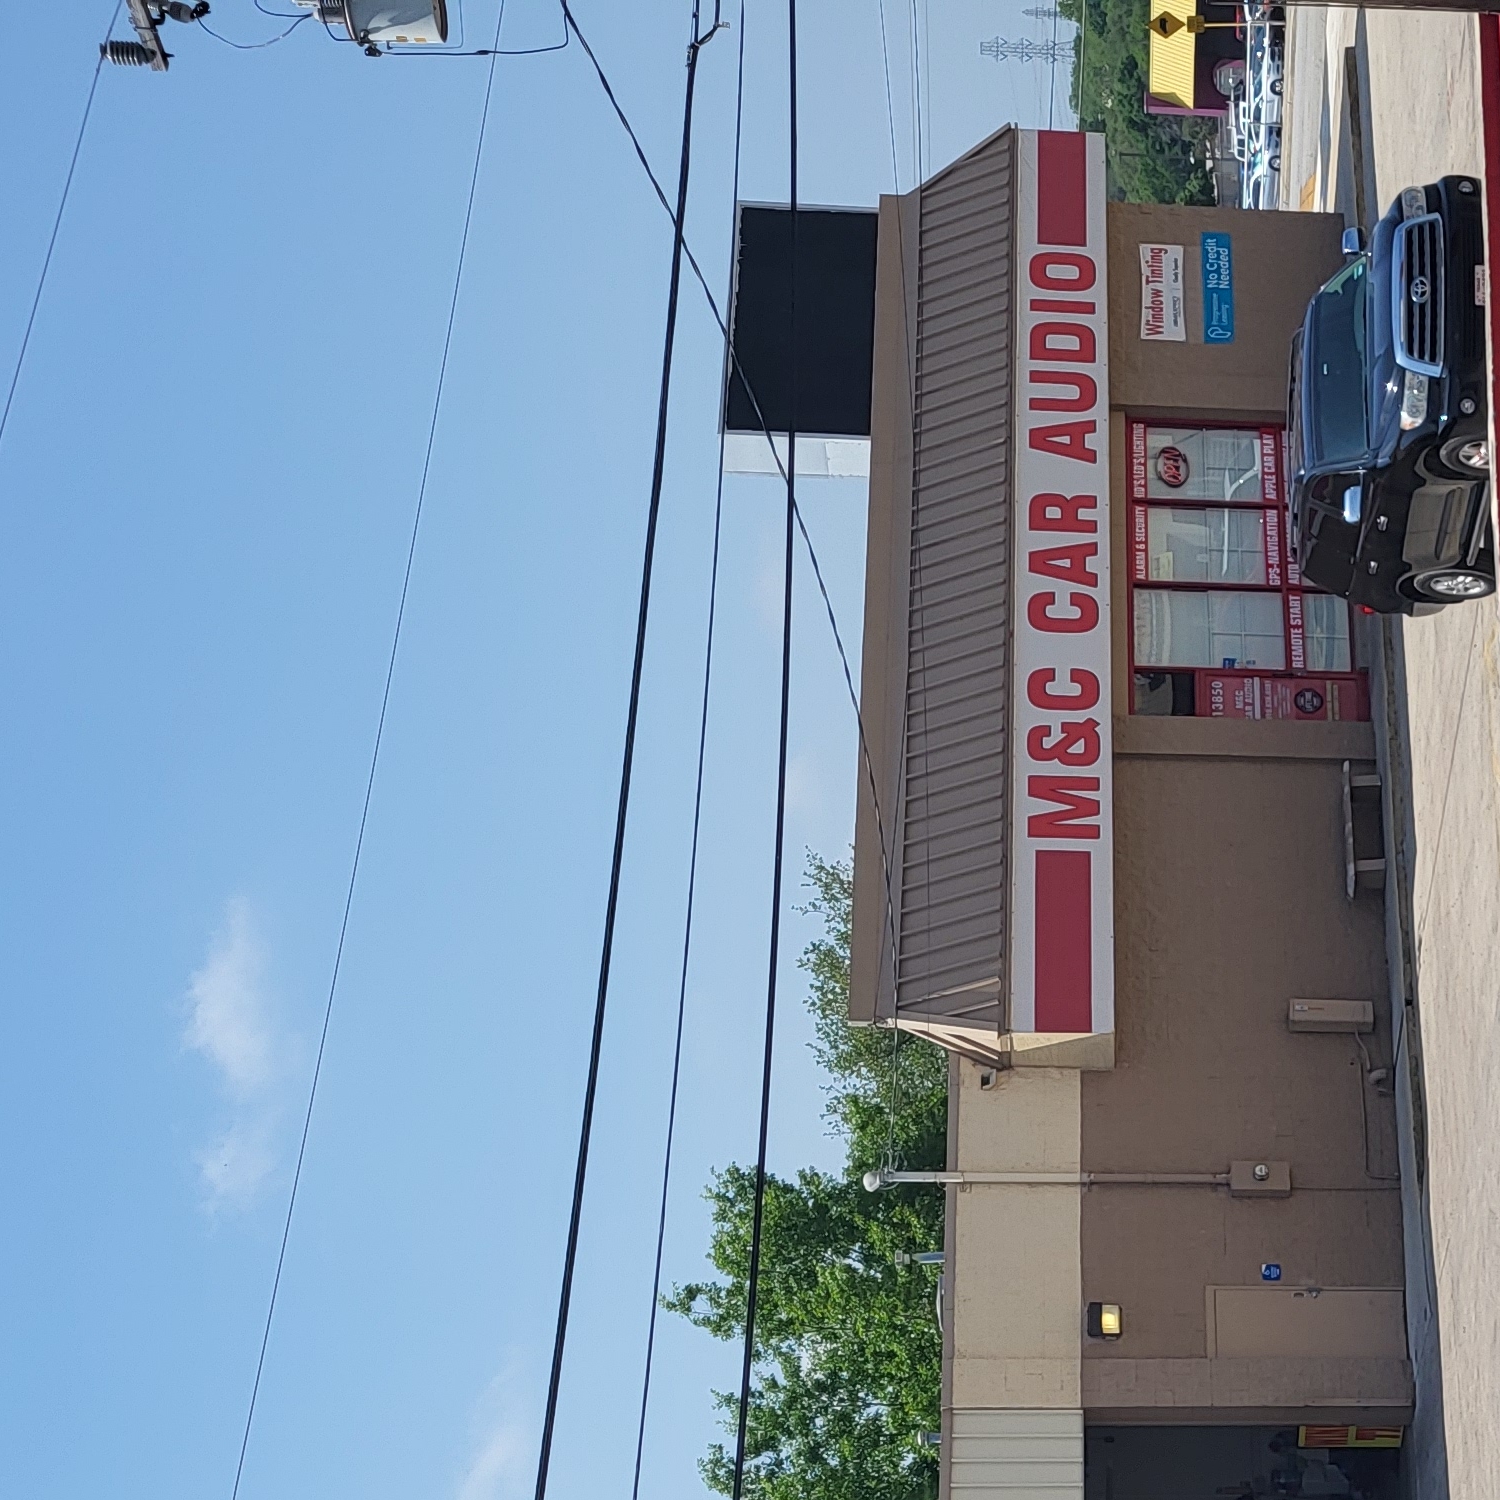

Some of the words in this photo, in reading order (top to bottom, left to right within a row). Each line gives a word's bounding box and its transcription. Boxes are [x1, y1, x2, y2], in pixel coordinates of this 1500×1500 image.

[1144, 247, 1168, 286] Tinting
[1204, 238, 1218, 270] Credit
[1217, 248, 1230, 289] Needed
[1206, 273, 1219, 288] No
[1144, 288, 1164, 337] Window
[1028, 251, 1098, 464] AUDIO
[1261, 433, 1275, 454] PLAY
[1161, 448, 1182, 484] OPEN
[1263, 455, 1276, 472] CAR
[1264, 473, 1277, 500] APPLE
[1133, 506, 1146, 542] SECURITY
[1027, 493, 1099, 634] CAR
[1134, 552, 1146, 580] ALARM
[1287, 563, 1300, 585] AUTO
[1288, 594, 1303, 625] START
[1291, 627, 1305, 668] REMOTE
[1211, 681, 1223, 717] 13850
[1027, 668, 1101, 839] M&C
